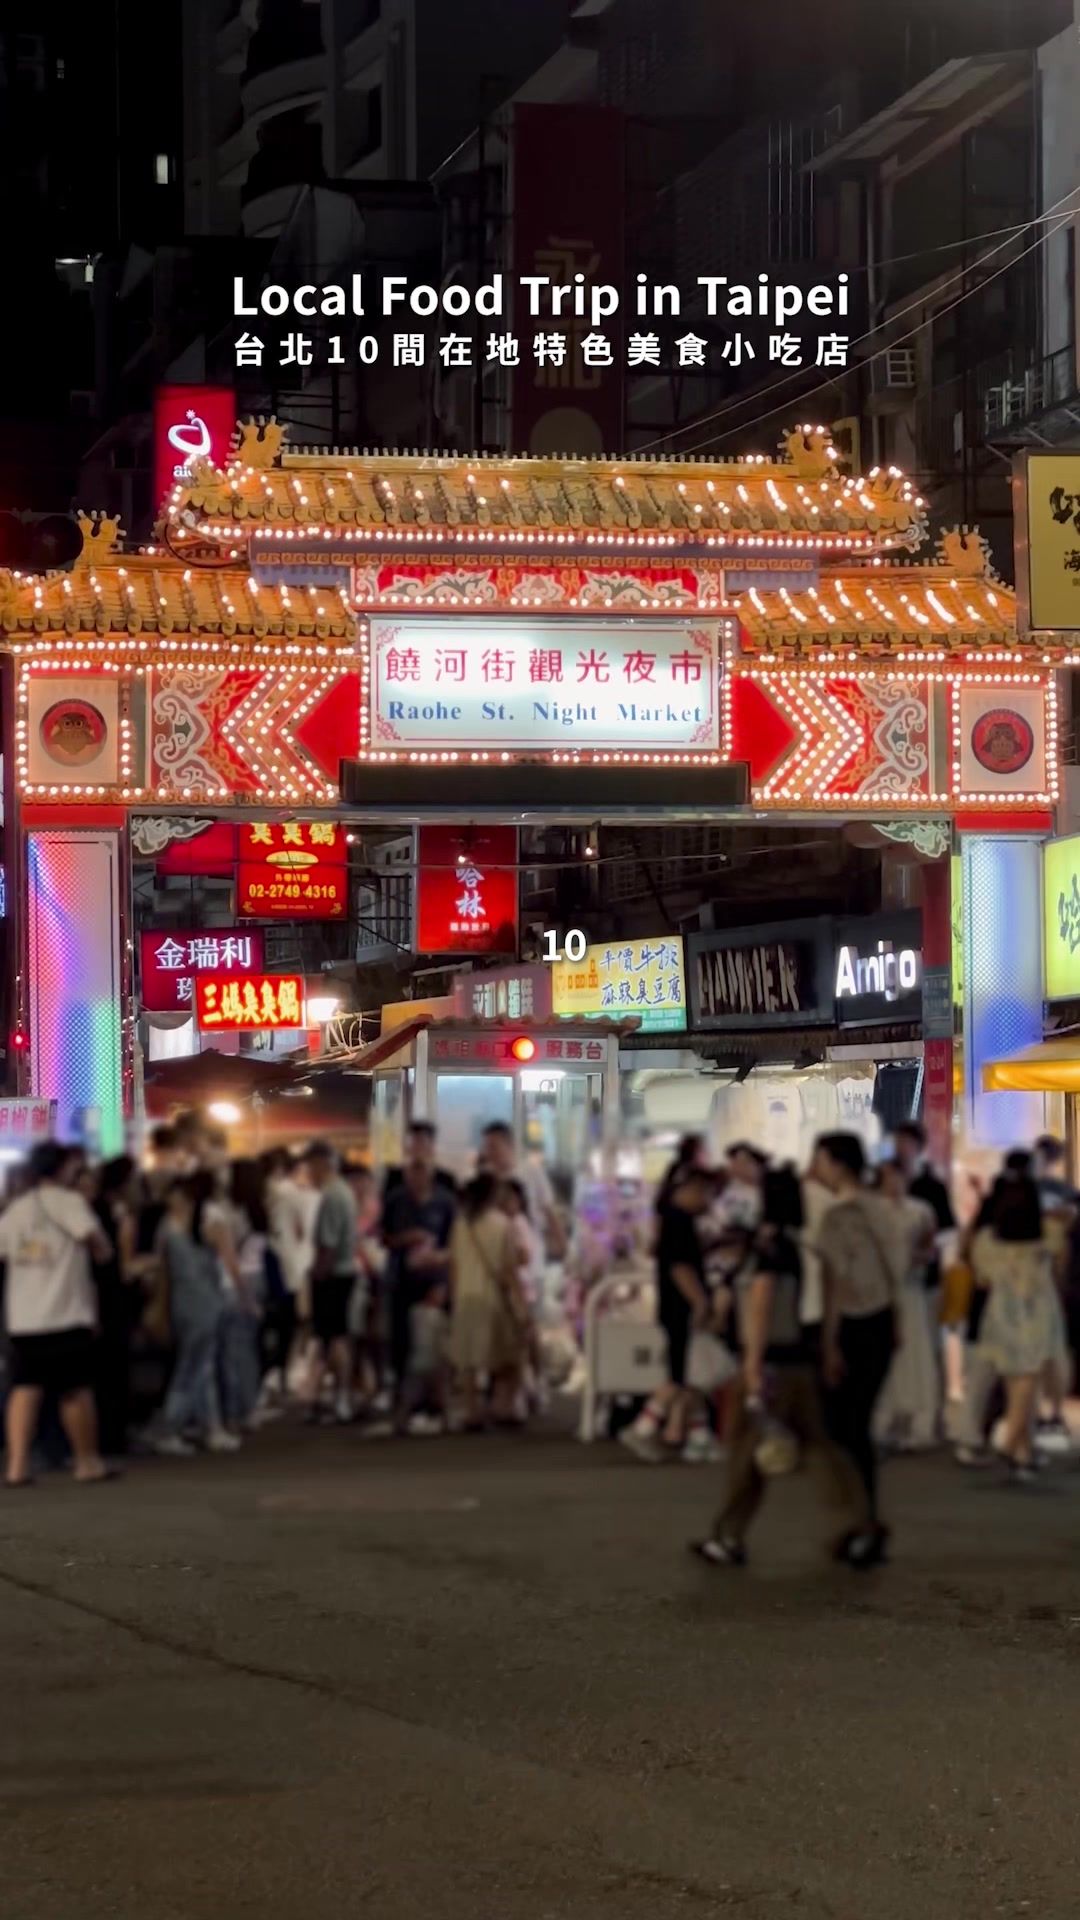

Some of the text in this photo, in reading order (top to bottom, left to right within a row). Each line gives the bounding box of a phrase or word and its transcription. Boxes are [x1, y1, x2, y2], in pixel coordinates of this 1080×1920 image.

[385, 647, 704, 685] 饒河街觀光夜市
[388, 701, 702, 726] Raohe St. Night Market
[154, 936, 251, 970] 金瑞利
[203, 980, 299, 1024] 三媽臭臭鍋
